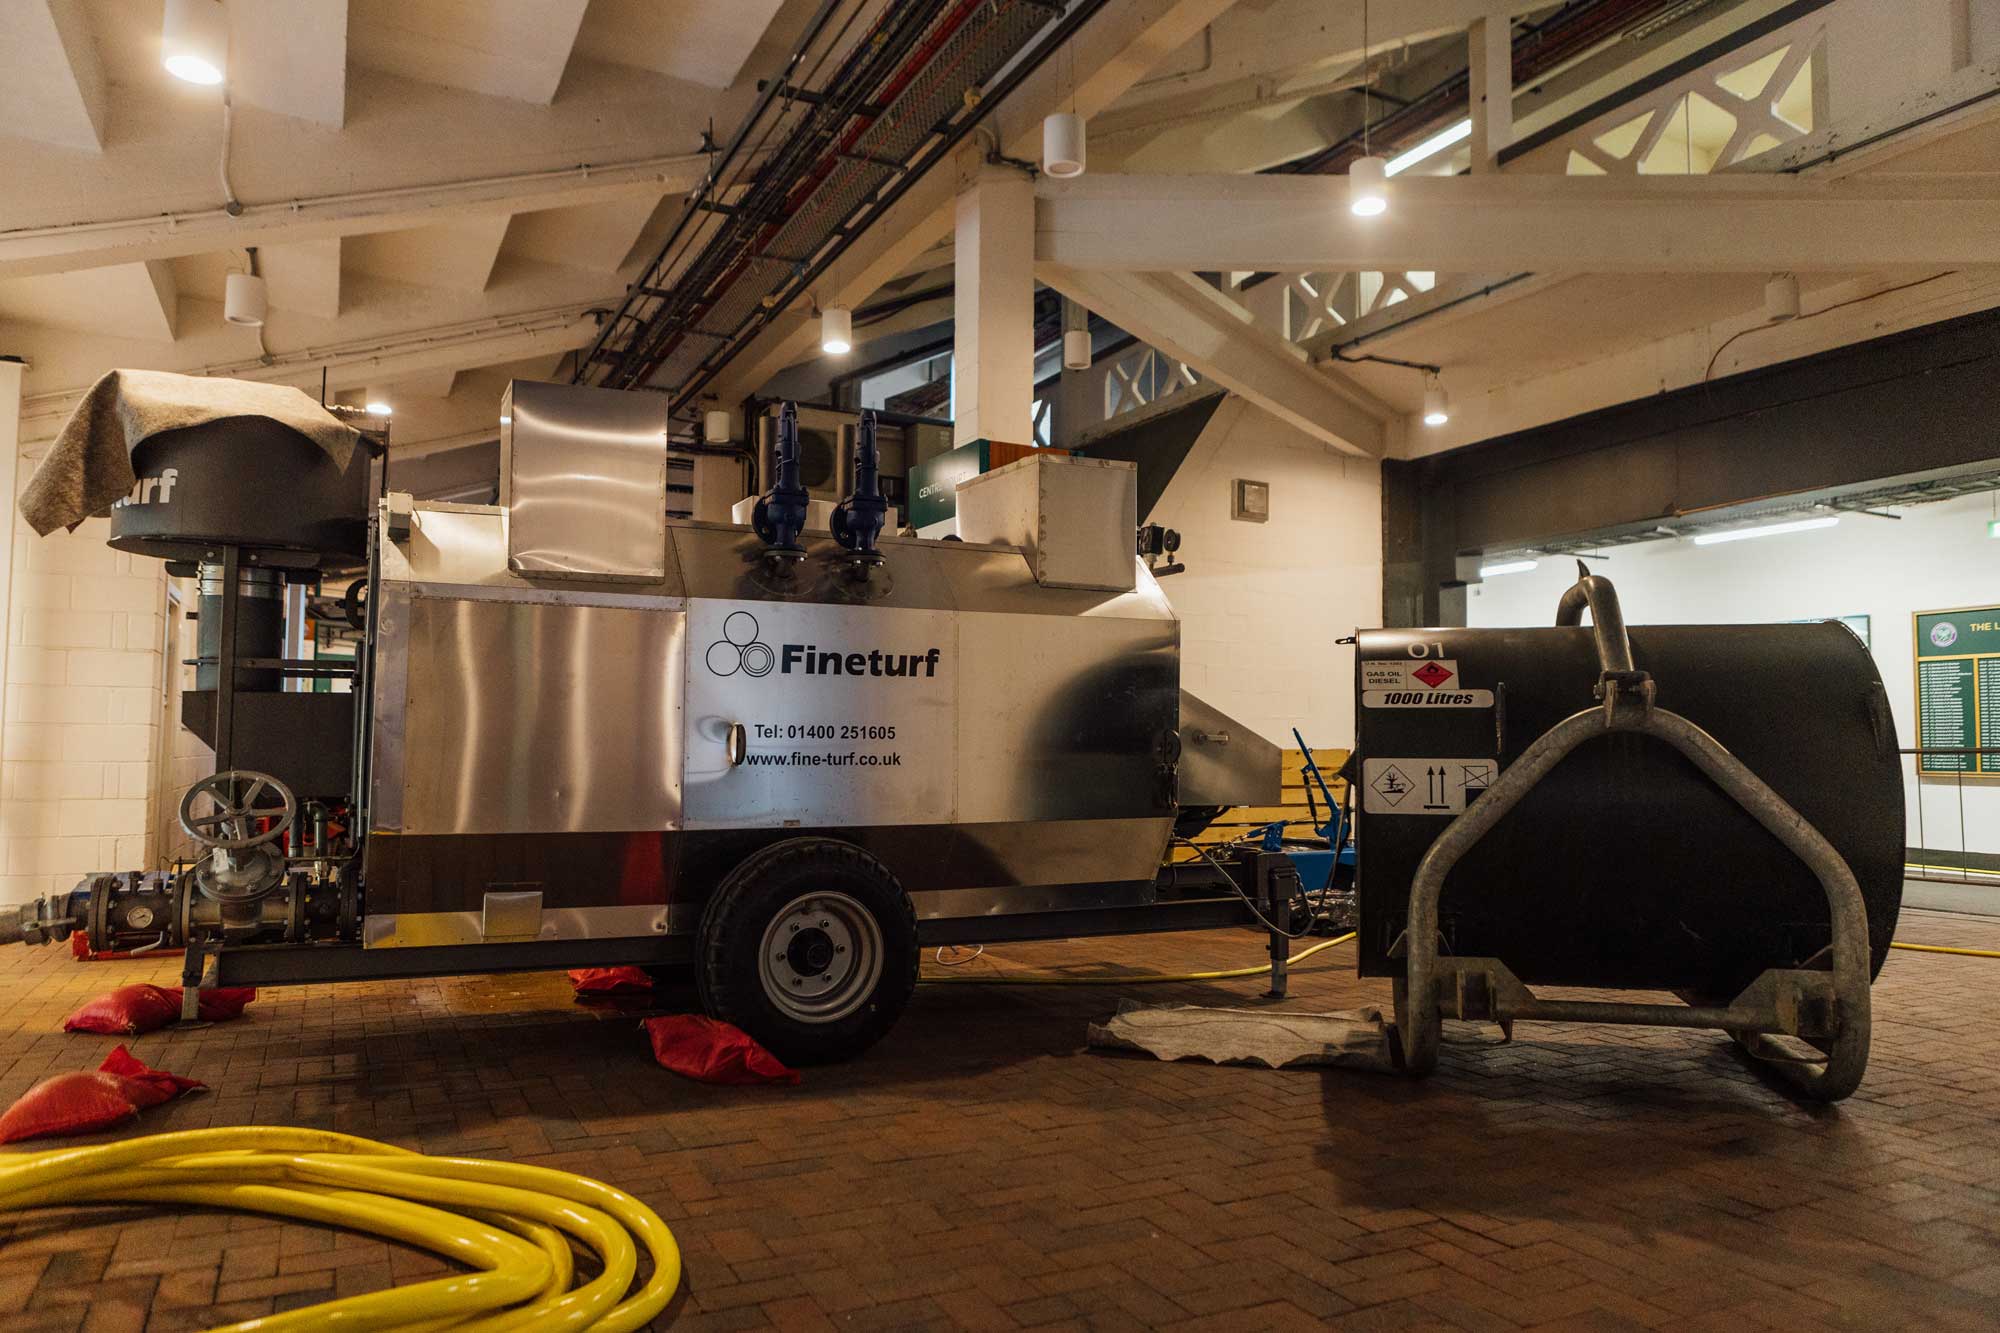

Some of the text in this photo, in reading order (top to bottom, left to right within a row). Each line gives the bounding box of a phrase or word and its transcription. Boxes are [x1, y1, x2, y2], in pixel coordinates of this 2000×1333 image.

[1969, 622, 1992, 632] THE
[781, 644, 940, 677] Fineturf
[1383, 692, 1474, 705] 1000 Litres
[754, 724, 896, 740] Tel: 01400 251605
[747, 752, 901, 766] www.fine-turf.co.uk
